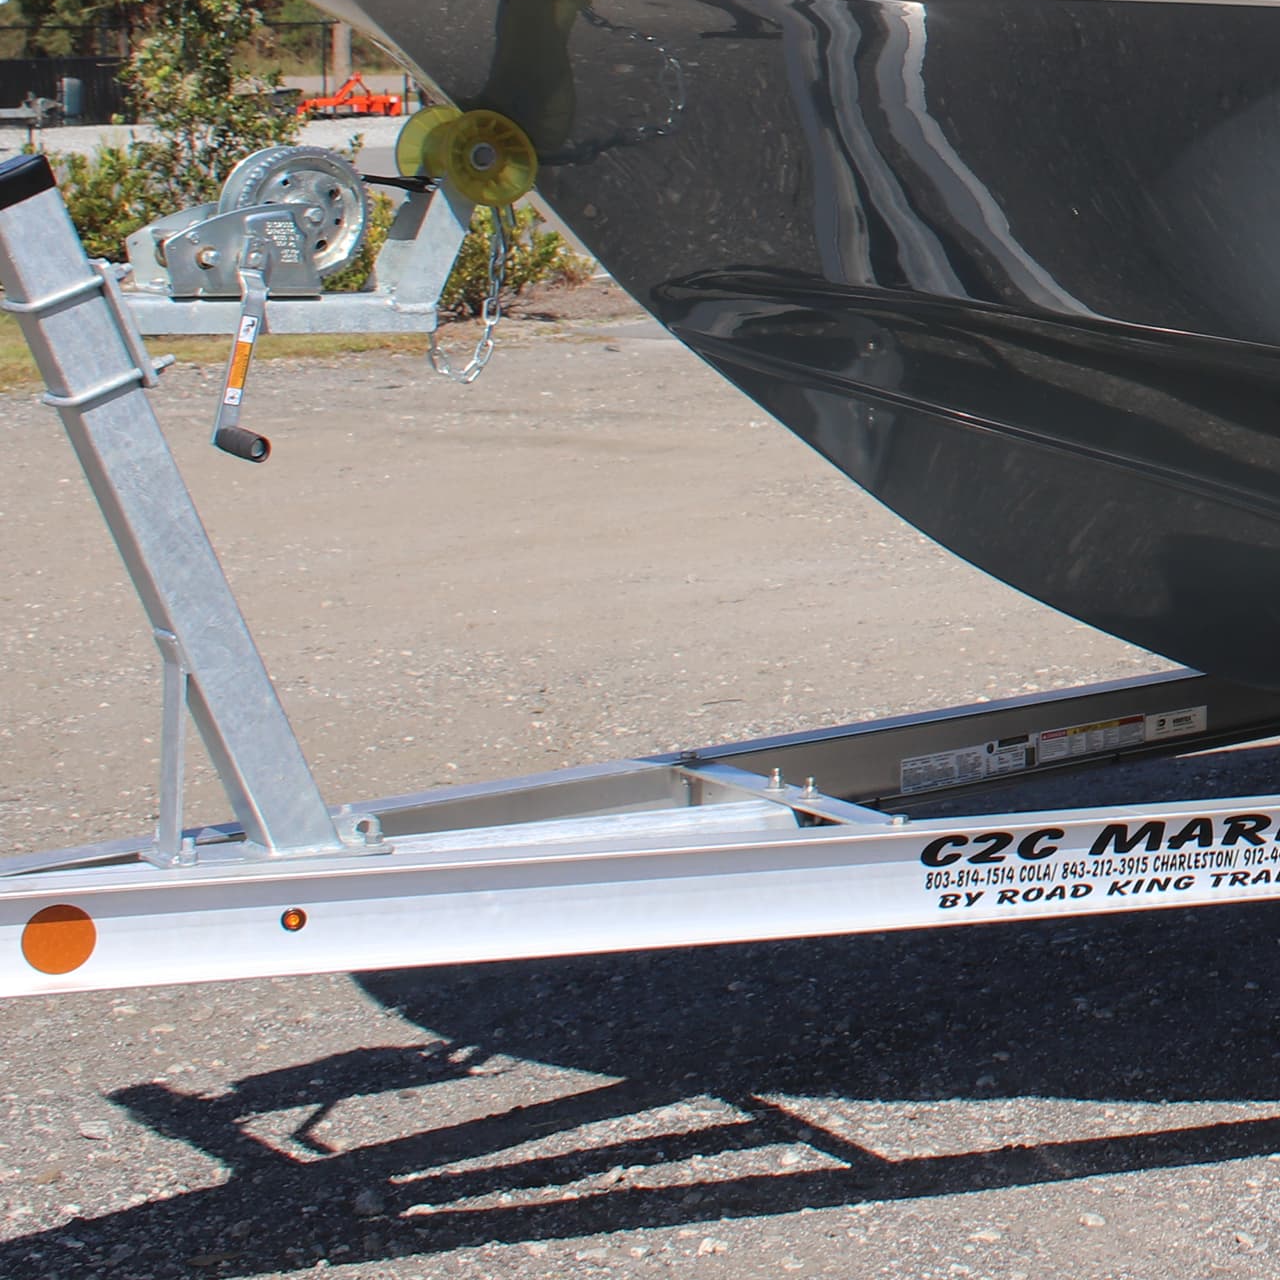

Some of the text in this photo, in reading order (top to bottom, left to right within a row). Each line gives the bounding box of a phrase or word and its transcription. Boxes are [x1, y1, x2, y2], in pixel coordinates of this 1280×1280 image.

[921, 828, 1064, 867] C2C
[925, 867, 1015, 890] 803-814-1514
[1019, 863, 1058, 883] COLA/
[1062, 856, 1148, 880] 843-212-3915
[1153, 849, 1240, 873] CHARLESTON/
[938, 891, 984, 909] BY
[997, 883, 1093, 905] ROAD
[1107, 875, 1195, 896] KING
